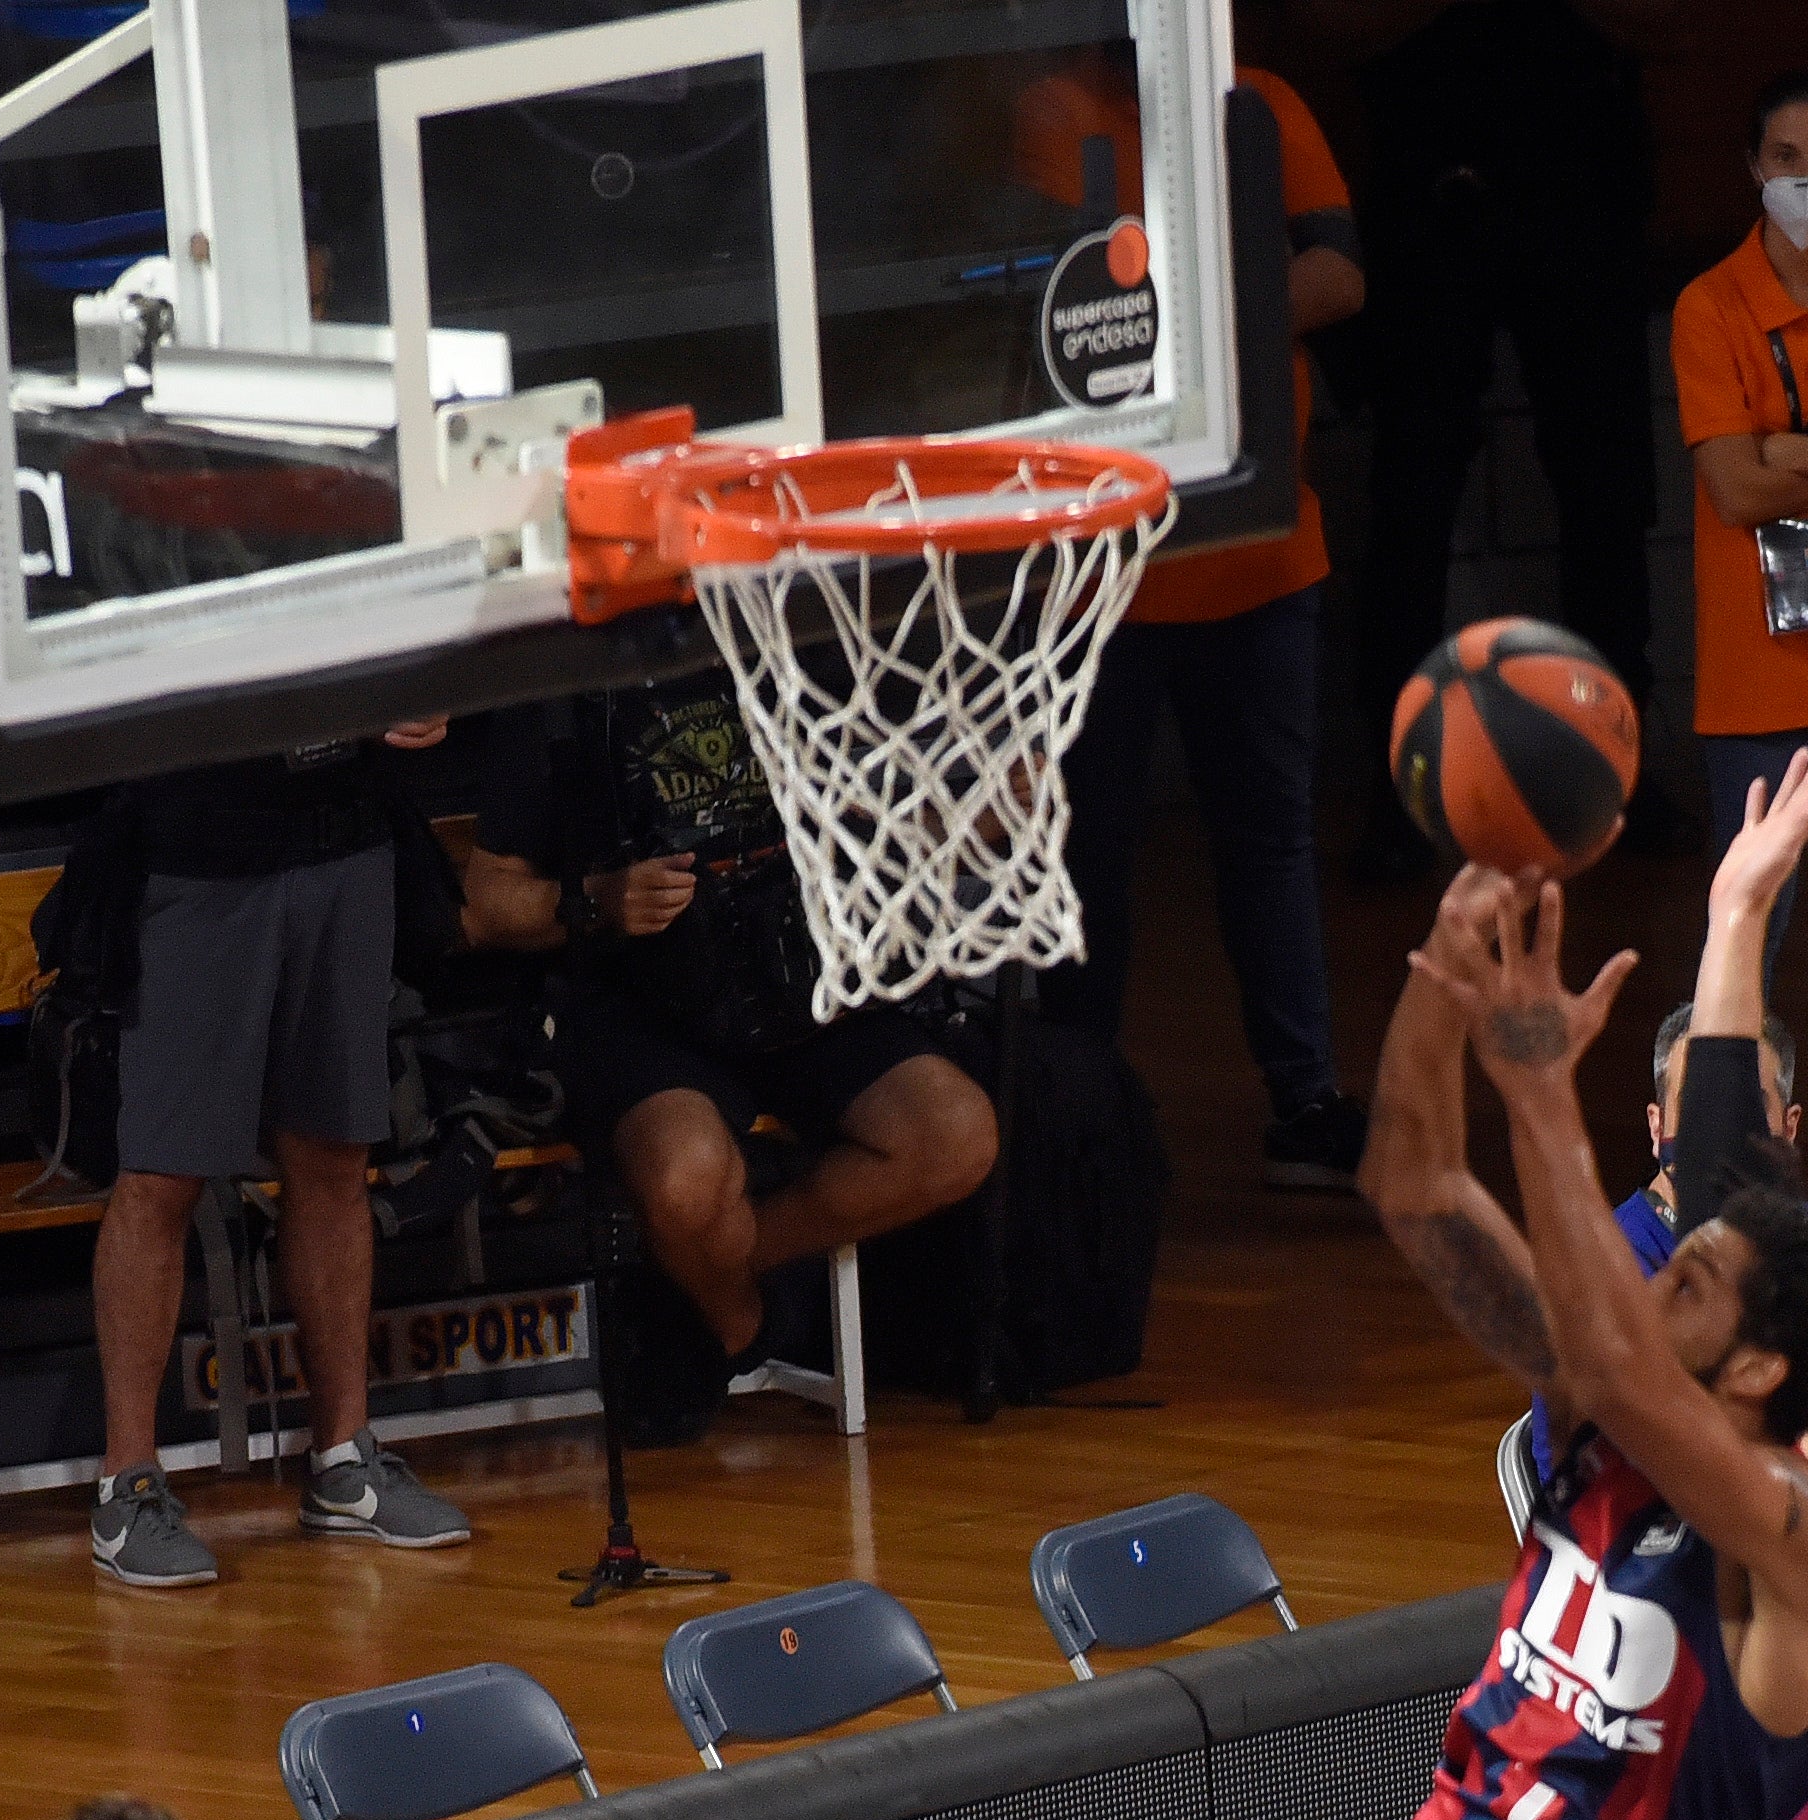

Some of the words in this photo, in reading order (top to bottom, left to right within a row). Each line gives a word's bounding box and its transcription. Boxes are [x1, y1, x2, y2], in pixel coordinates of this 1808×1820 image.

[1053, 290, 1152, 331] supercopa
[1063, 316, 1154, 360] endesa
[410, 1290, 581, 1372] SPORT
[1132, 1539, 1143, 1563] 5
[782, 1631, 798, 1650] 19
[1498, 1627, 1665, 1755] SYSTEMS
[411, 1713, 420, 1732] 1
